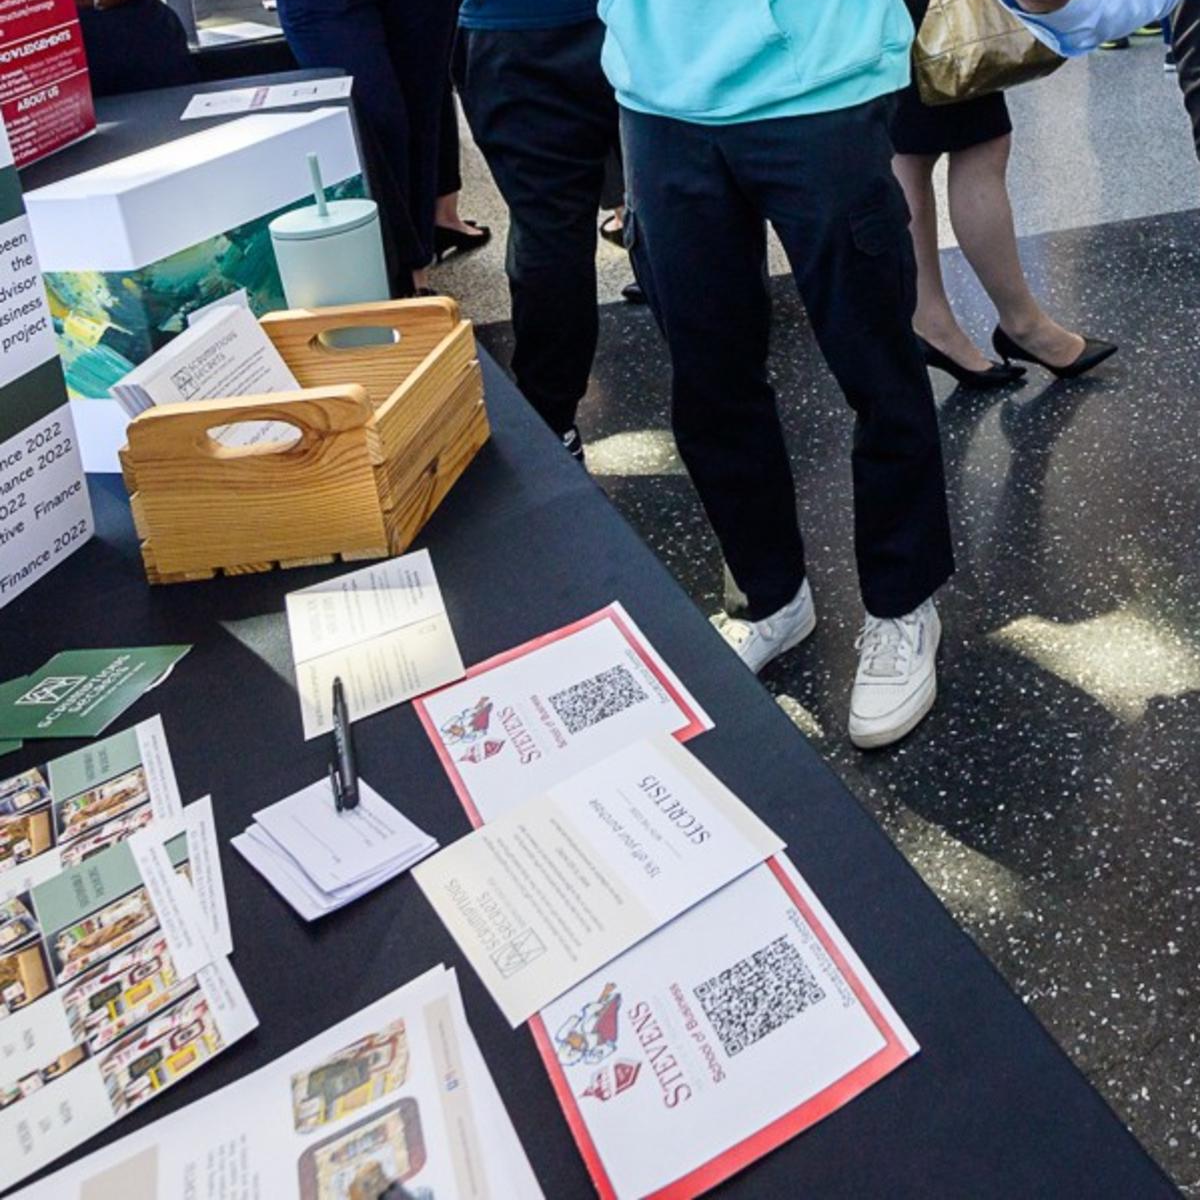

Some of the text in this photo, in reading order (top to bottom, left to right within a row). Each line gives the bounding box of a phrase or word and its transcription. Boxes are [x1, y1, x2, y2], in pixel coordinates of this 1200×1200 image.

[0, 29, 71, 63] OWLEDGEMENTS
[17, 85, 60, 113] ABOUT US
[11, 253, 33, 272] the
[2, 317, 48, 353] project
[0, 421, 62, 472] nce 2022
[37, 438, 73, 471] 2022
[33, 479, 82, 521] Finance
[0, 519, 88, 594] Finance 2022
[497, 706, 542, 765] STEVENS
[589, 799, 624, 832] purchase
[669, 982, 726, 1084] School of Business
[628, 1001, 692, 1109] STEVENS
